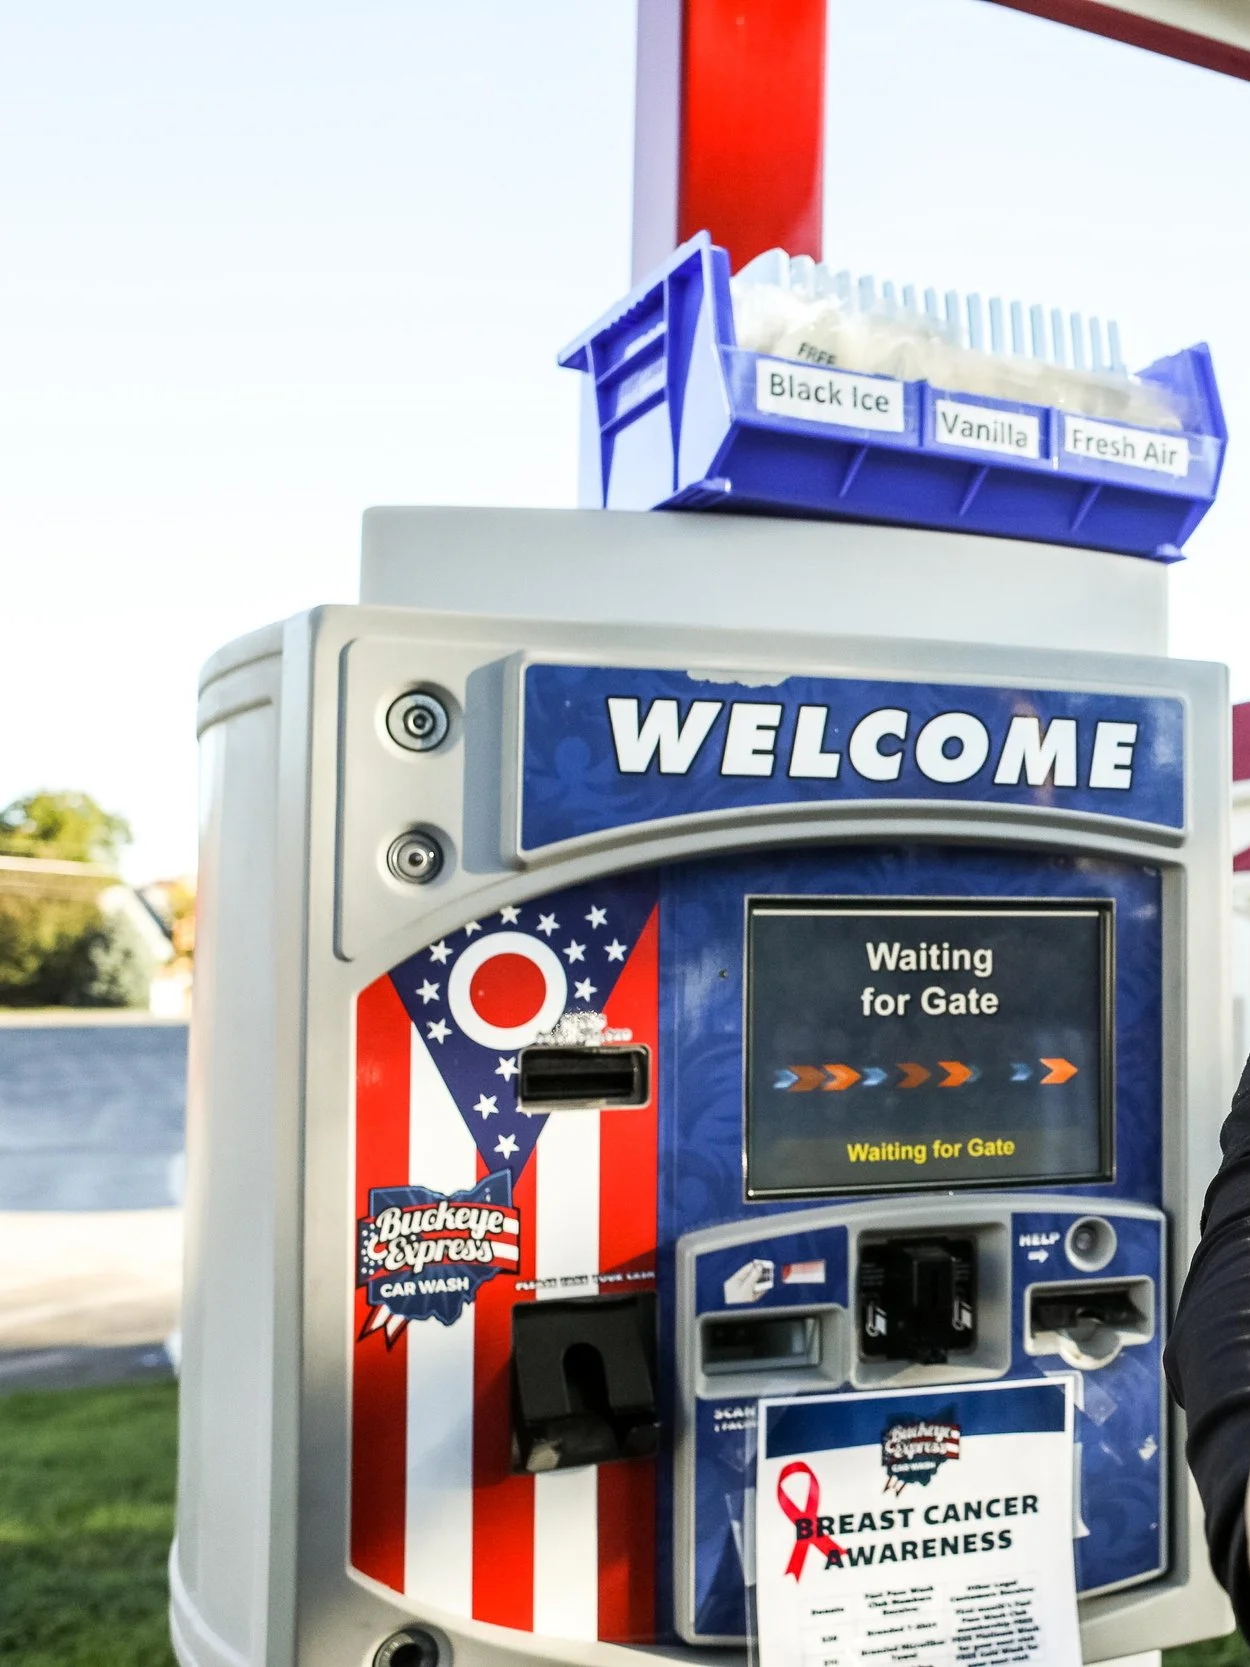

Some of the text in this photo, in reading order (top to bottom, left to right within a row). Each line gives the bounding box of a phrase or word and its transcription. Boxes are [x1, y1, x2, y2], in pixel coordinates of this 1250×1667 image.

[769, 373, 891, 413] Black Ice
[941, 410, 1029, 449] Vanilla
[1072, 428, 1178, 467] Fresh Air
[606, 697, 1139, 790] WELCOME
[866, 942, 994, 977] Waiting
[861, 986, 999, 1016] for Gate
[847, 1137, 1015, 1164] Waiting for Gate
[376, 1200, 504, 1243] Buckeye
[1019, 1231, 1061, 1248] HELP
[385, 1236, 494, 1274] Express
[380, 1277, 470, 1298] CAR WASH
[795, 1494, 1039, 1539] BREAST CANCER
[823, 1530, 1012, 1571] AWARENESS
